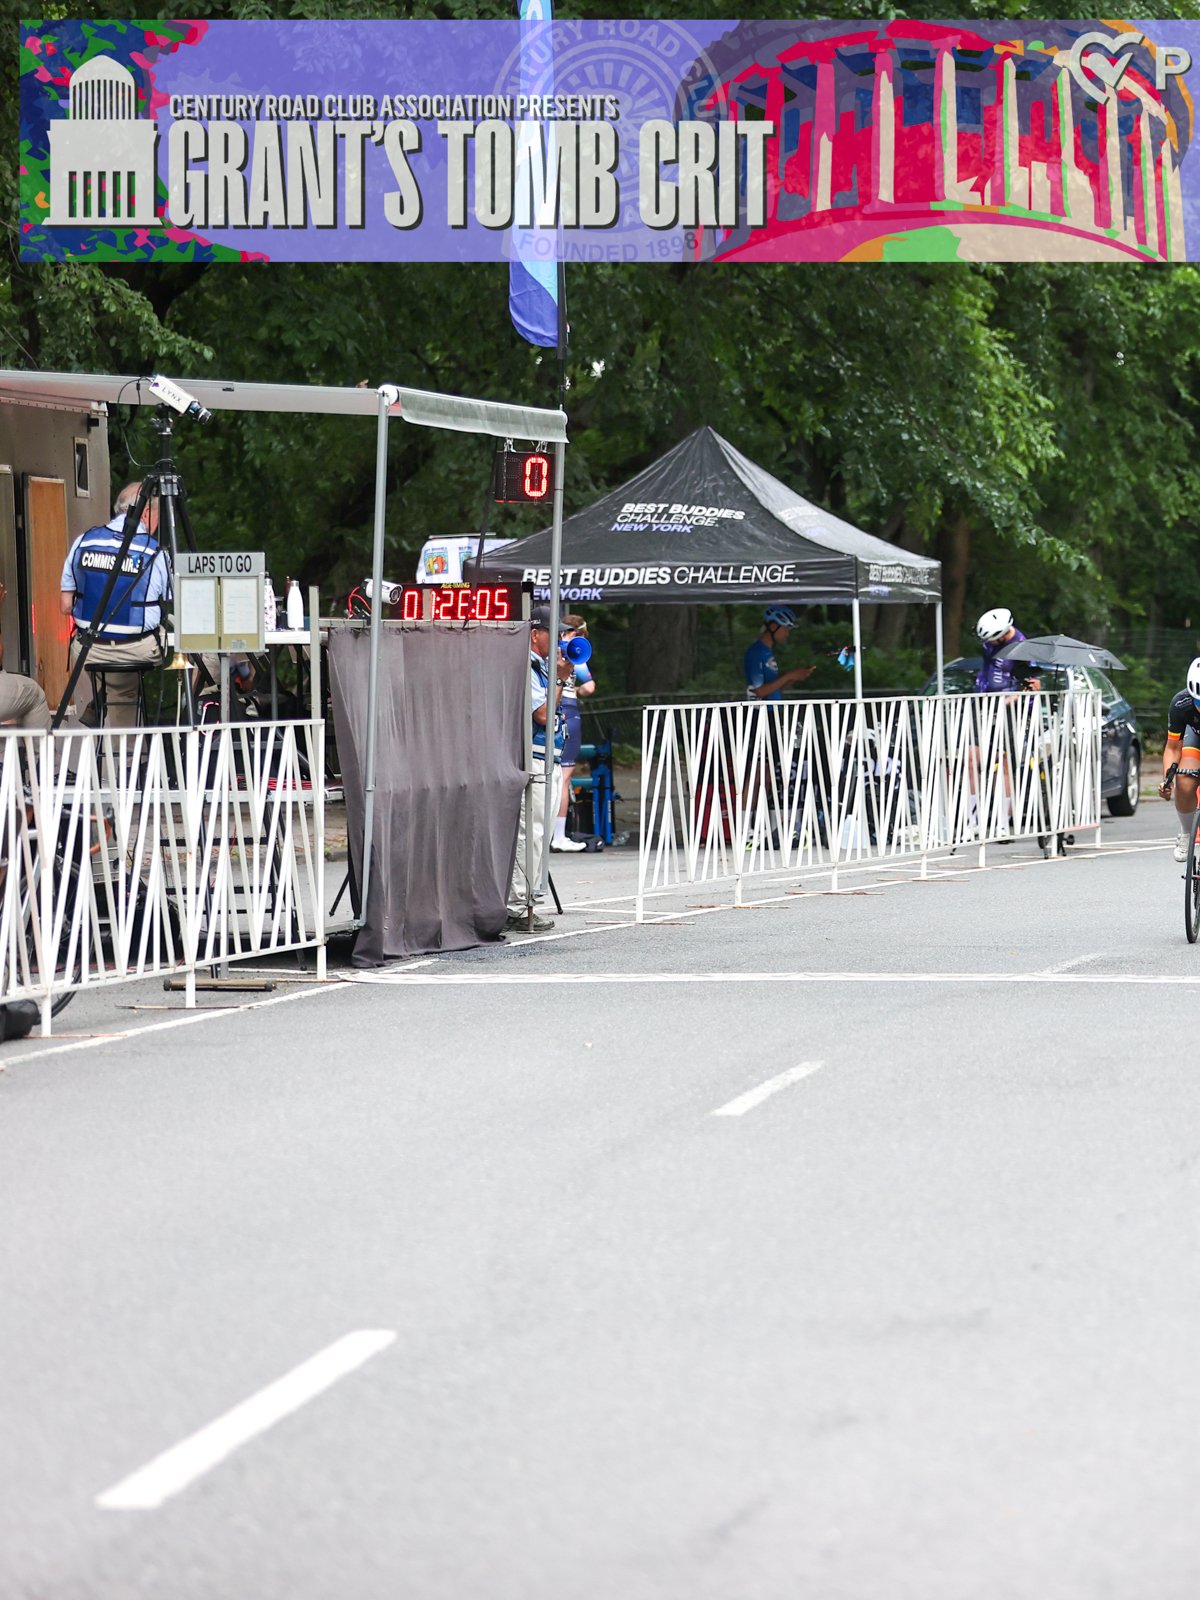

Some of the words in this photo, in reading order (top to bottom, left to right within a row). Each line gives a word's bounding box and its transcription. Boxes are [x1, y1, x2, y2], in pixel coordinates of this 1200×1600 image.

[525, 456, 548, 498] 0
[621, 502, 669, 514] BEST
[669, 503, 746, 520] BUDDIES
[610, 523, 649, 532] NEW
[651, 523, 694, 533] YORK
[81, 552, 141, 574] COMMISAIR
[188, 555, 216, 574] LAPS
[218, 555, 233, 573] TO
[235, 554, 252, 573] GO
[579, 566, 672, 586] BUDDIES
[559, 587, 604, 601] YORK
